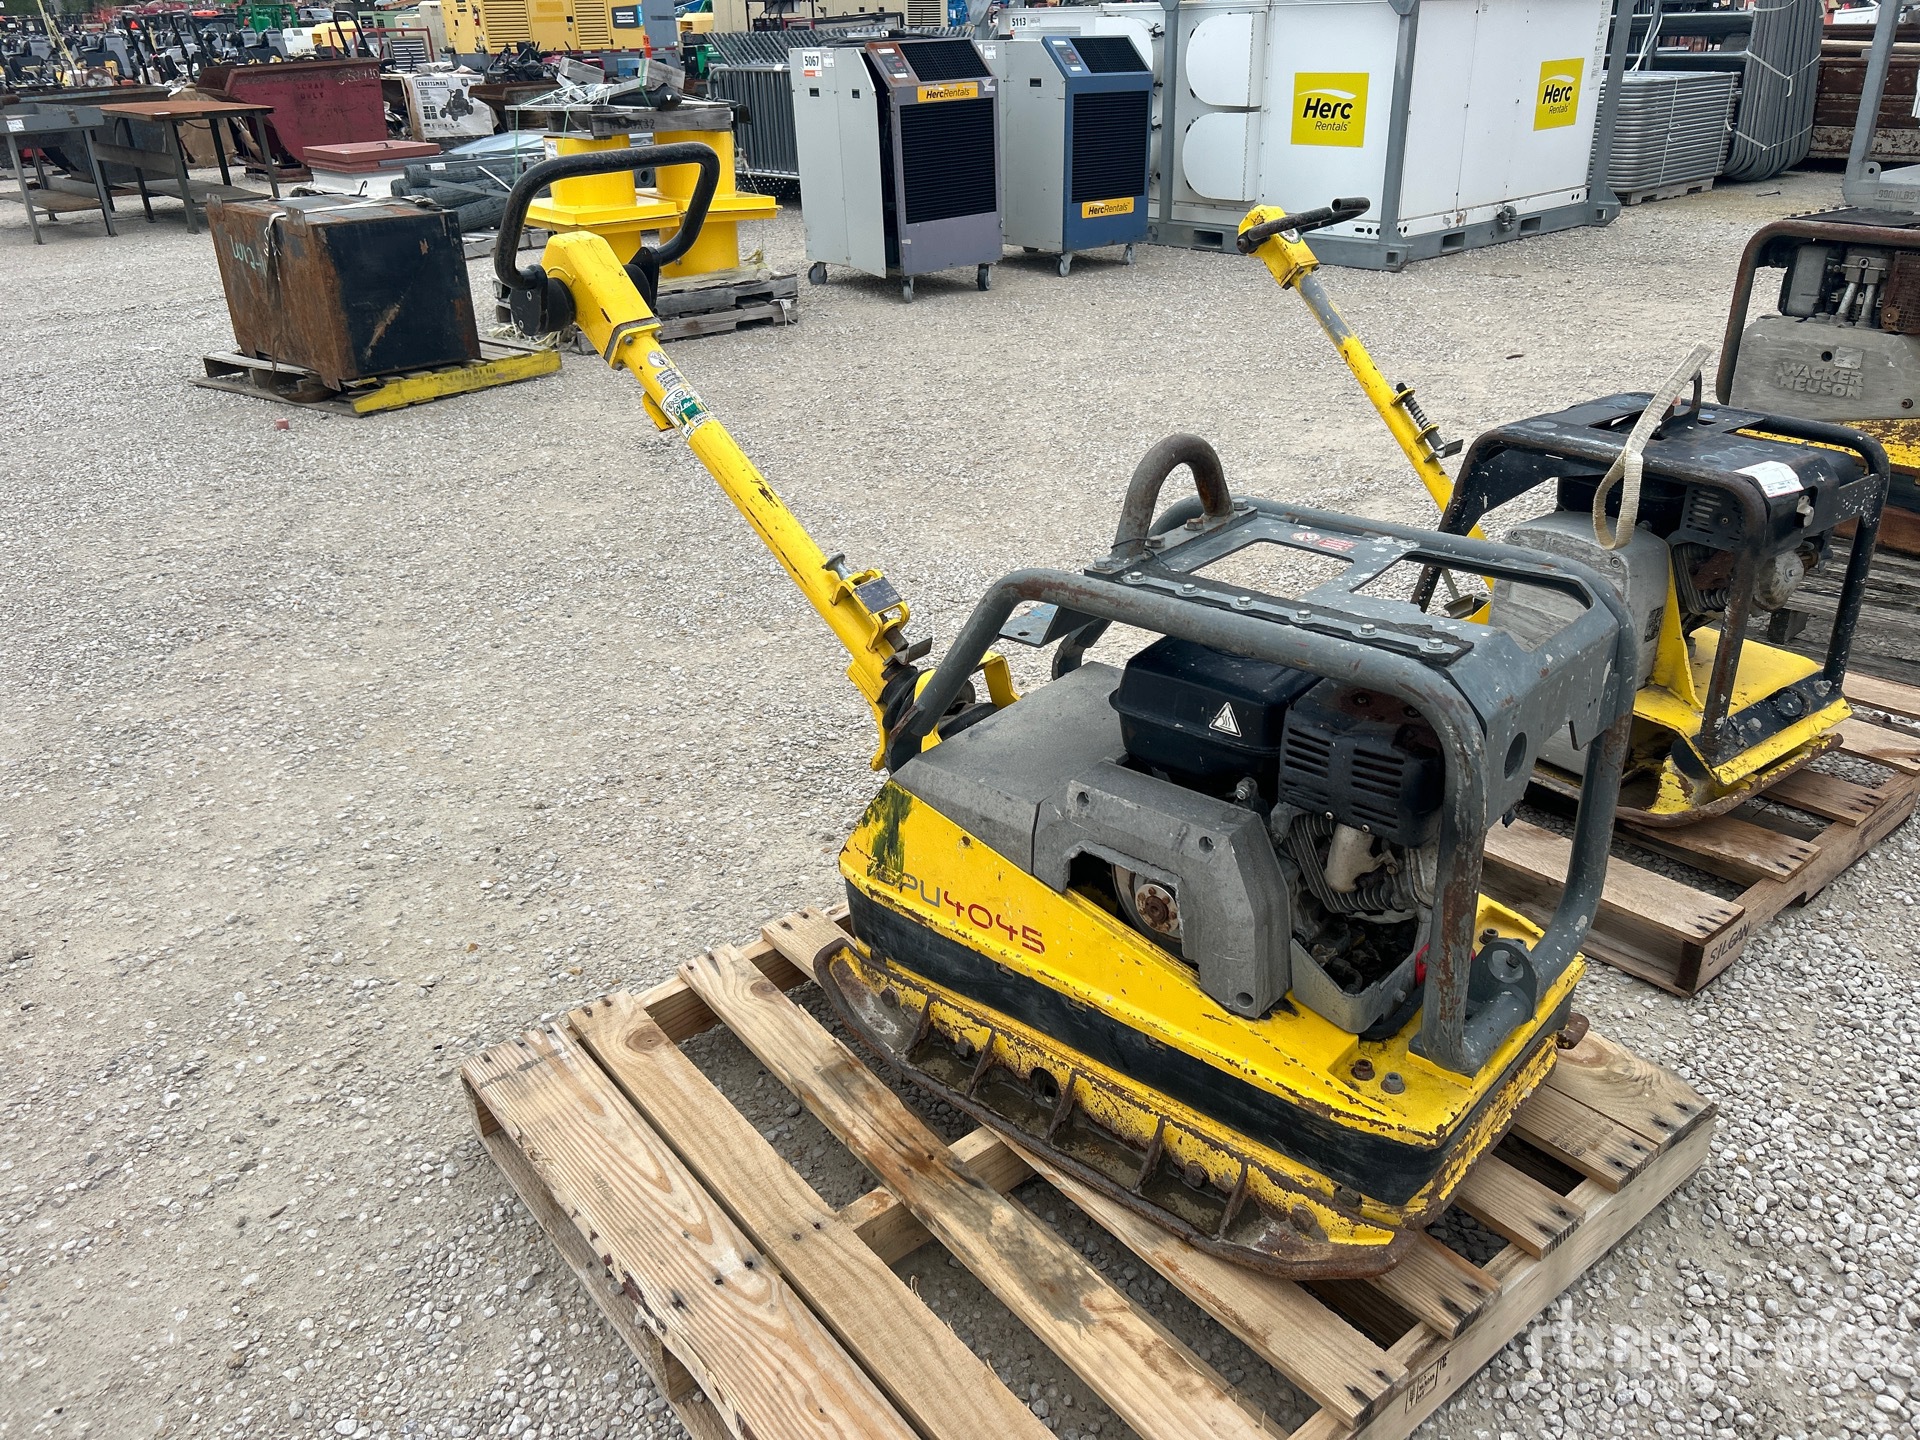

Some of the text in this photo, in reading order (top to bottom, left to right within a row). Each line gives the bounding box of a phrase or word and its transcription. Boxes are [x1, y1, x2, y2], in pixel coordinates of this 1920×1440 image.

[1011, 17, 1027, 27] 5113
[804, 55, 820, 67] 5067
[1542, 84, 1573, 105] Herc
[1302, 97, 1354, 120] Herc
[1548, 104, 1569, 115] Rentals
[1314, 120, 1348, 132] Rentals
[1779, 361, 1865, 387] WACKER
[1779, 375, 1864, 400] NEUSON
